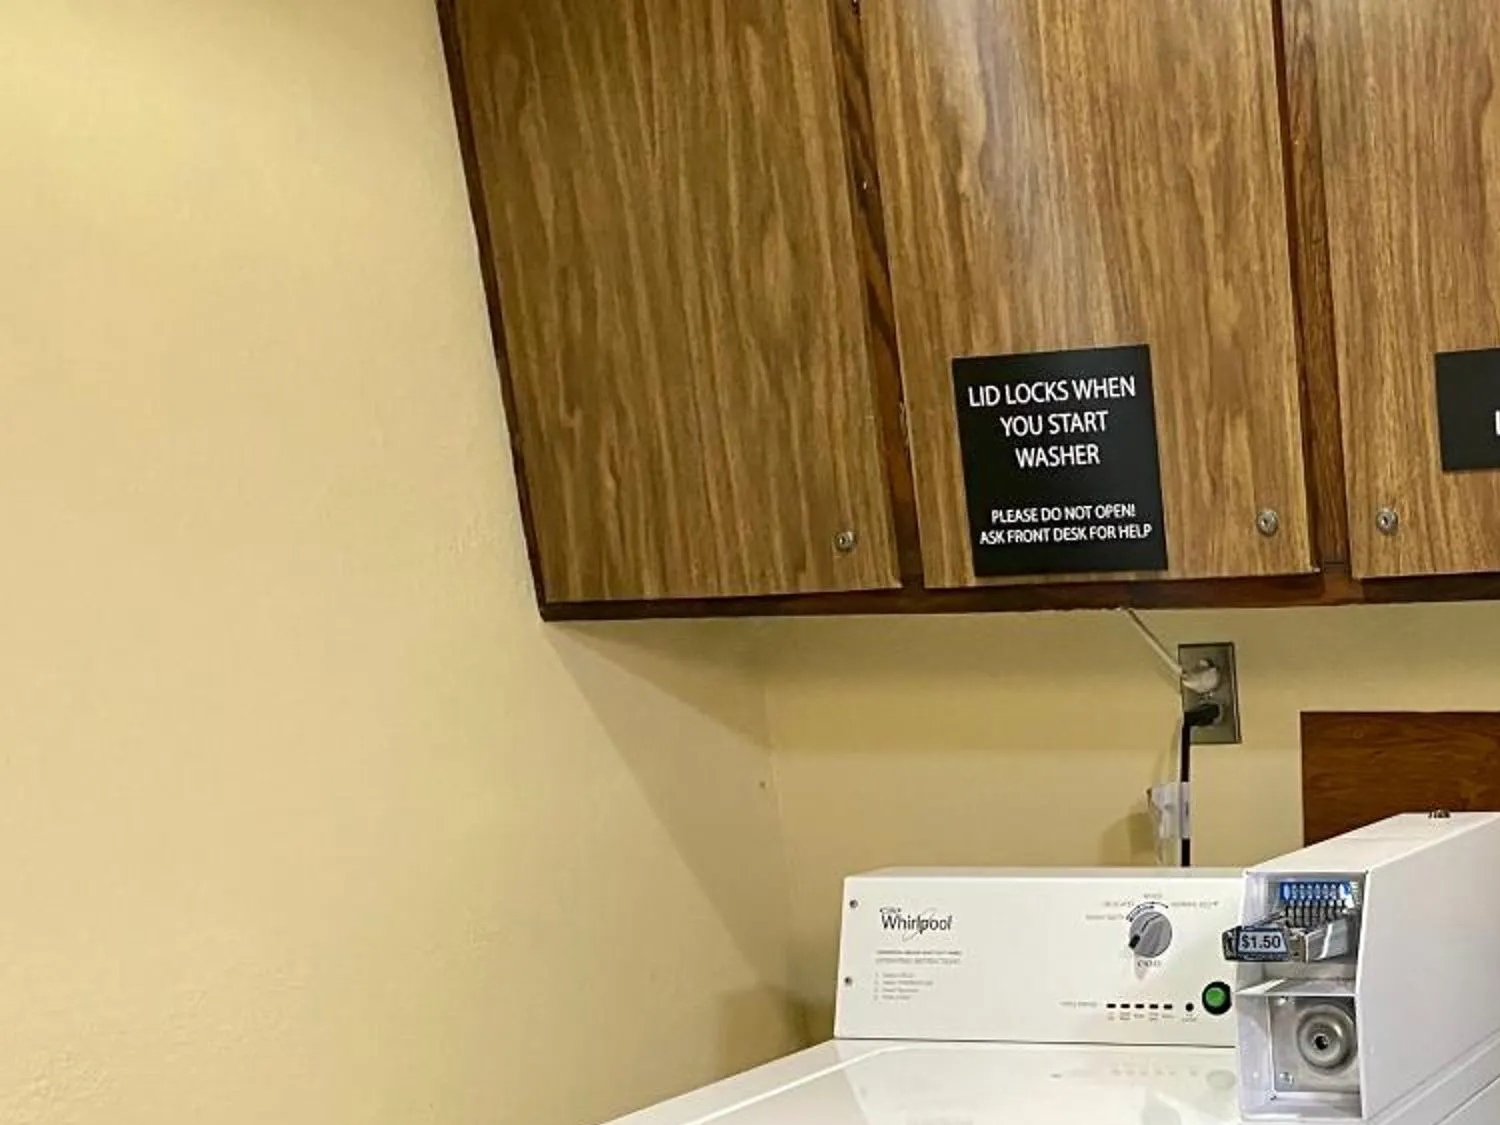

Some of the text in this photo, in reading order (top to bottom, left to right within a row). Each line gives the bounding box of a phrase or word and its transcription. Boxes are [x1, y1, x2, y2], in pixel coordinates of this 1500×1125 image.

[968, 375, 1136, 407] LID LOCKS WHEN
[1000, 410, 1109, 437] YOU START
[1015, 443, 1100, 468] WASHER
[991, 503, 1136, 524] PLEASE DO NOT OPEN!
[979, 523, 1152, 545] ASK FRONT DESK FOR HELP
[881, 914, 953, 935] Whirlpool
[1241, 934, 1281, 950] $1.50
